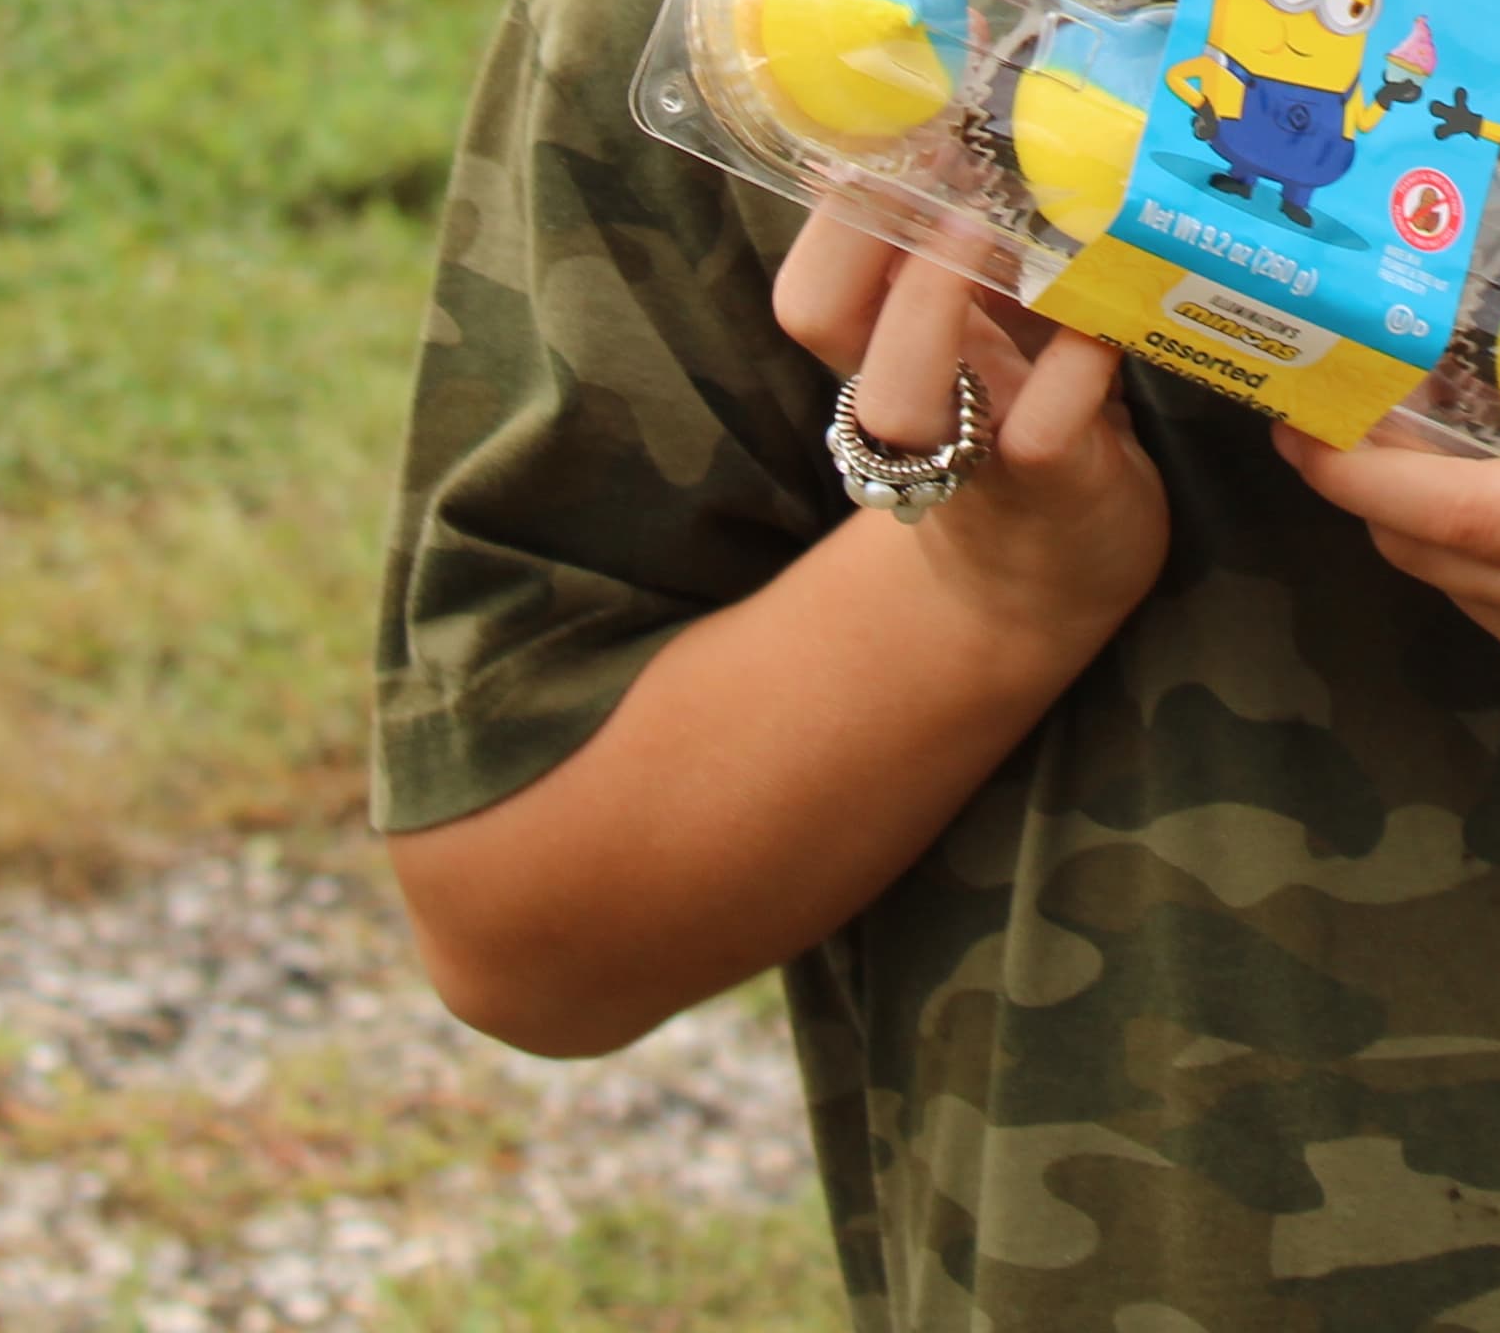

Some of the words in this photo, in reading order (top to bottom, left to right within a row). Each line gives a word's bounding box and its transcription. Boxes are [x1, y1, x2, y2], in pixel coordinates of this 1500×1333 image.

[1138, 198, 1175, 233] Net
[1198, 225, 1232, 257] 9.2
[1227, 242, 1254, 267] oz
[1289, 267, 1319, 297] g)
[1145, 330, 1271, 389] assorted
